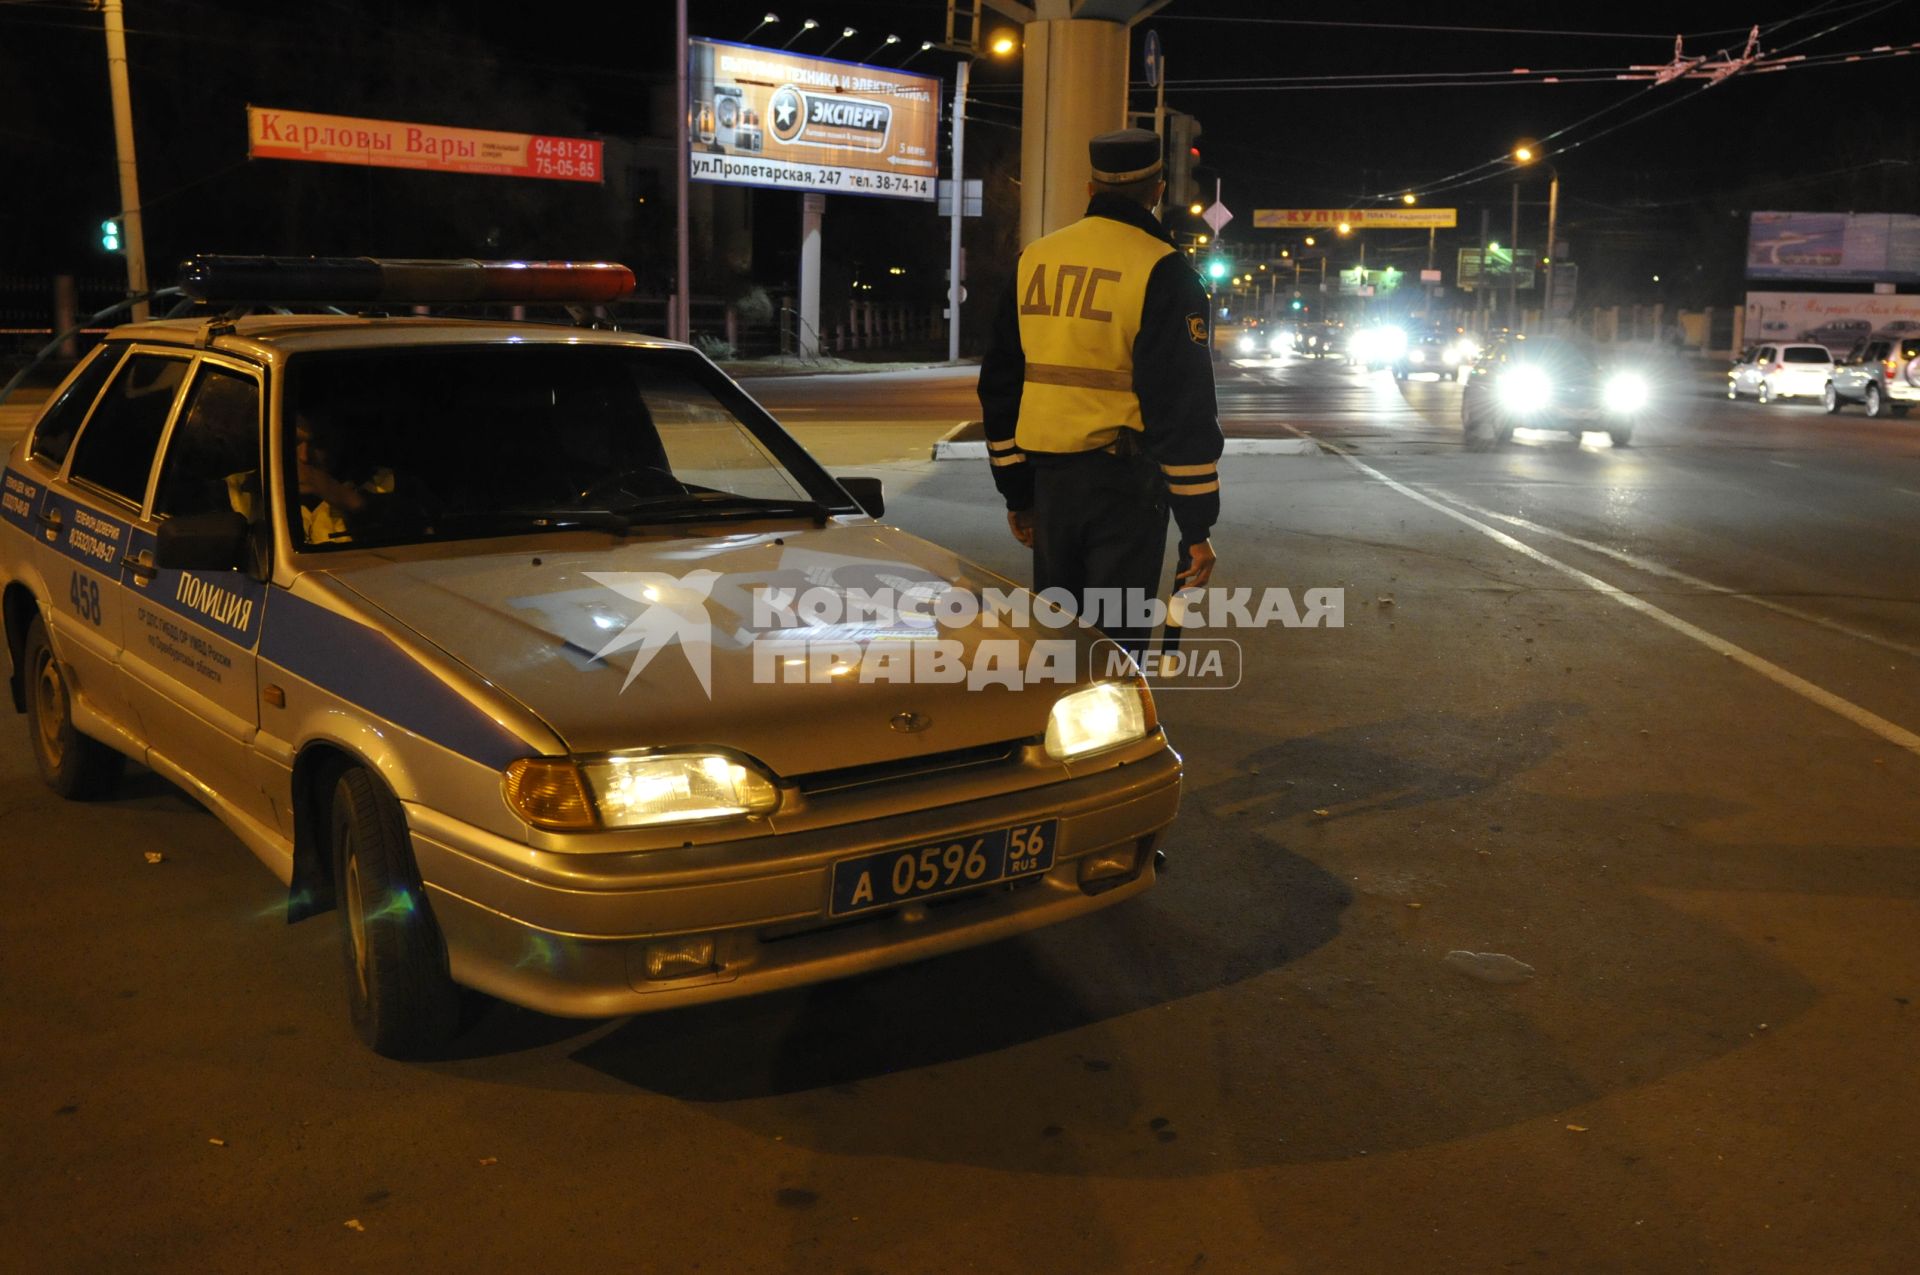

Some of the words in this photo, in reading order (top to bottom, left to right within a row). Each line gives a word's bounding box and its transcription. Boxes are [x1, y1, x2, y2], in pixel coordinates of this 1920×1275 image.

[787, 67, 840, 87] ТЕХНИКА
[841, 76, 850, 88] И
[811, 102, 883, 130] ЭКСПЕРТ
[260, 113, 392, 154] Карловы
[406, 127, 475, 162] Вары
[535, 138, 594, 160] 94-81-21
[535, 157, 595, 177] 75-05-85
[818, 170, 842, 185] 247
[849, 175, 873, 188] тел.
[875, 175, 927, 193] 38-74-14
[1287, 210, 1363, 222] КУПИМ
[1020, 264, 1122, 322] ДПС
[70, 570, 102, 626] 458
[176, 571, 253, 632] ПОЛИЦИЯ
[1009, 825, 1044, 860] 56
[851, 871, 873, 905] А
[892, 838, 986, 896] 0596
[1012, 857, 1037, 873] RUS
